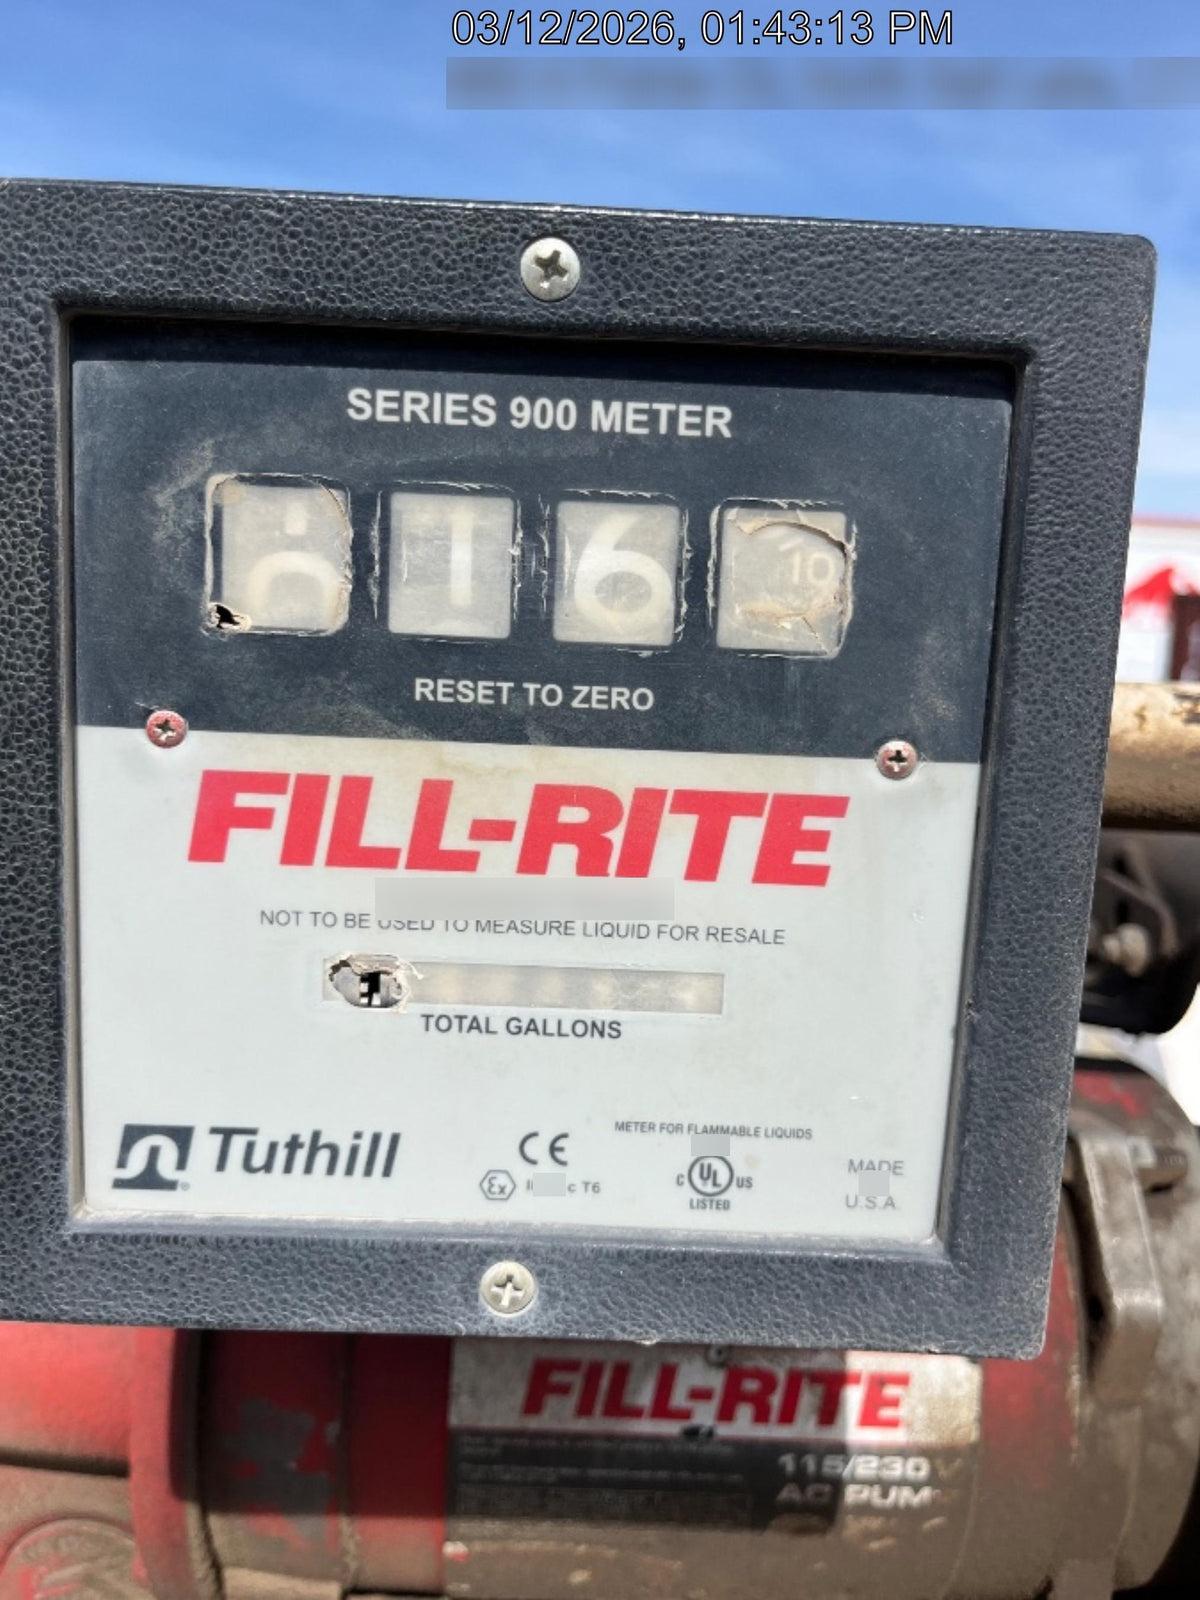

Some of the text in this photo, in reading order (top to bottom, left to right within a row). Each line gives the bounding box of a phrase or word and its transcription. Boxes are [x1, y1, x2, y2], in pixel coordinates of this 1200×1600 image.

[346, 387, 733, 439] SERIES 900 METER
[413, 678, 655, 712] RESET TO ZERO
[187, 769, 850, 887] FILL-RITE
[260, 909, 304, 927] NOT
[309, 911, 337, 929] TO
[343, 913, 371, 930] BE
[475, 918, 576, 937] MEASURE
[582, 921, 650, 940] LIQUID
[657, 924, 700, 942] FOR
[705, 926, 786, 946] RESALE
[420, 1014, 623, 1040] TOTAL GALLONS
[615, 1121, 813, 1140] METER FOR FLAMMABLE LIQUIDS
[208, 1126, 401, 1178] Tuthill
[518, 1131, 570, 1167] CE
[700, 1162, 722, 1189] UL
[736, 1176, 753, 1189] US
[848, 1159, 904, 1176] MADE
[582, 1181, 601, 1194] T6
[689, 1199, 731, 1211] LISTED
[521, 1356, 911, 1429] FILL-RITE
[779, 1452, 931, 1483] 115/230
